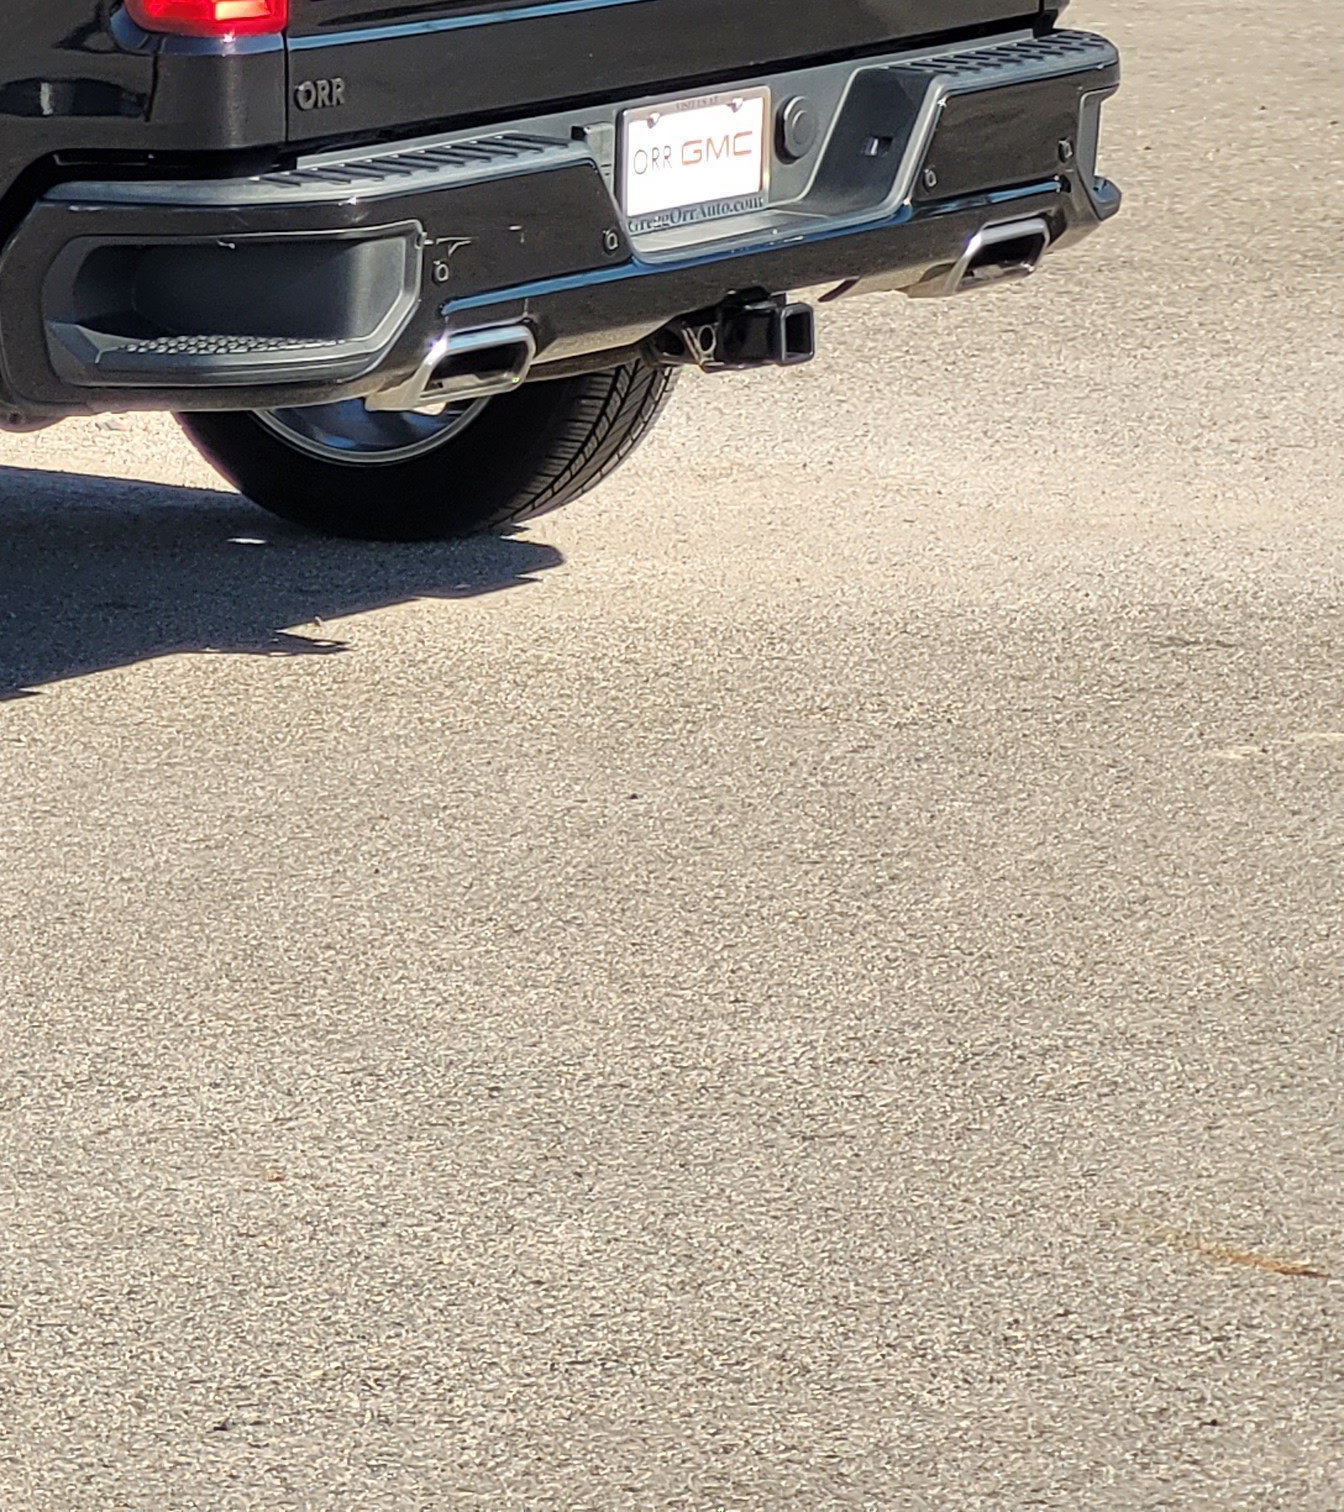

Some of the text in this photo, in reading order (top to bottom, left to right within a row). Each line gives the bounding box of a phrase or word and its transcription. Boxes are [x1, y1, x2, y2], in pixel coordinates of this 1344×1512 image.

[296, 77, 345, 110] ORR
[634, 131, 752, 175] ORR GMC
[628, 197, 763, 233] GreggOrrAuto.com
